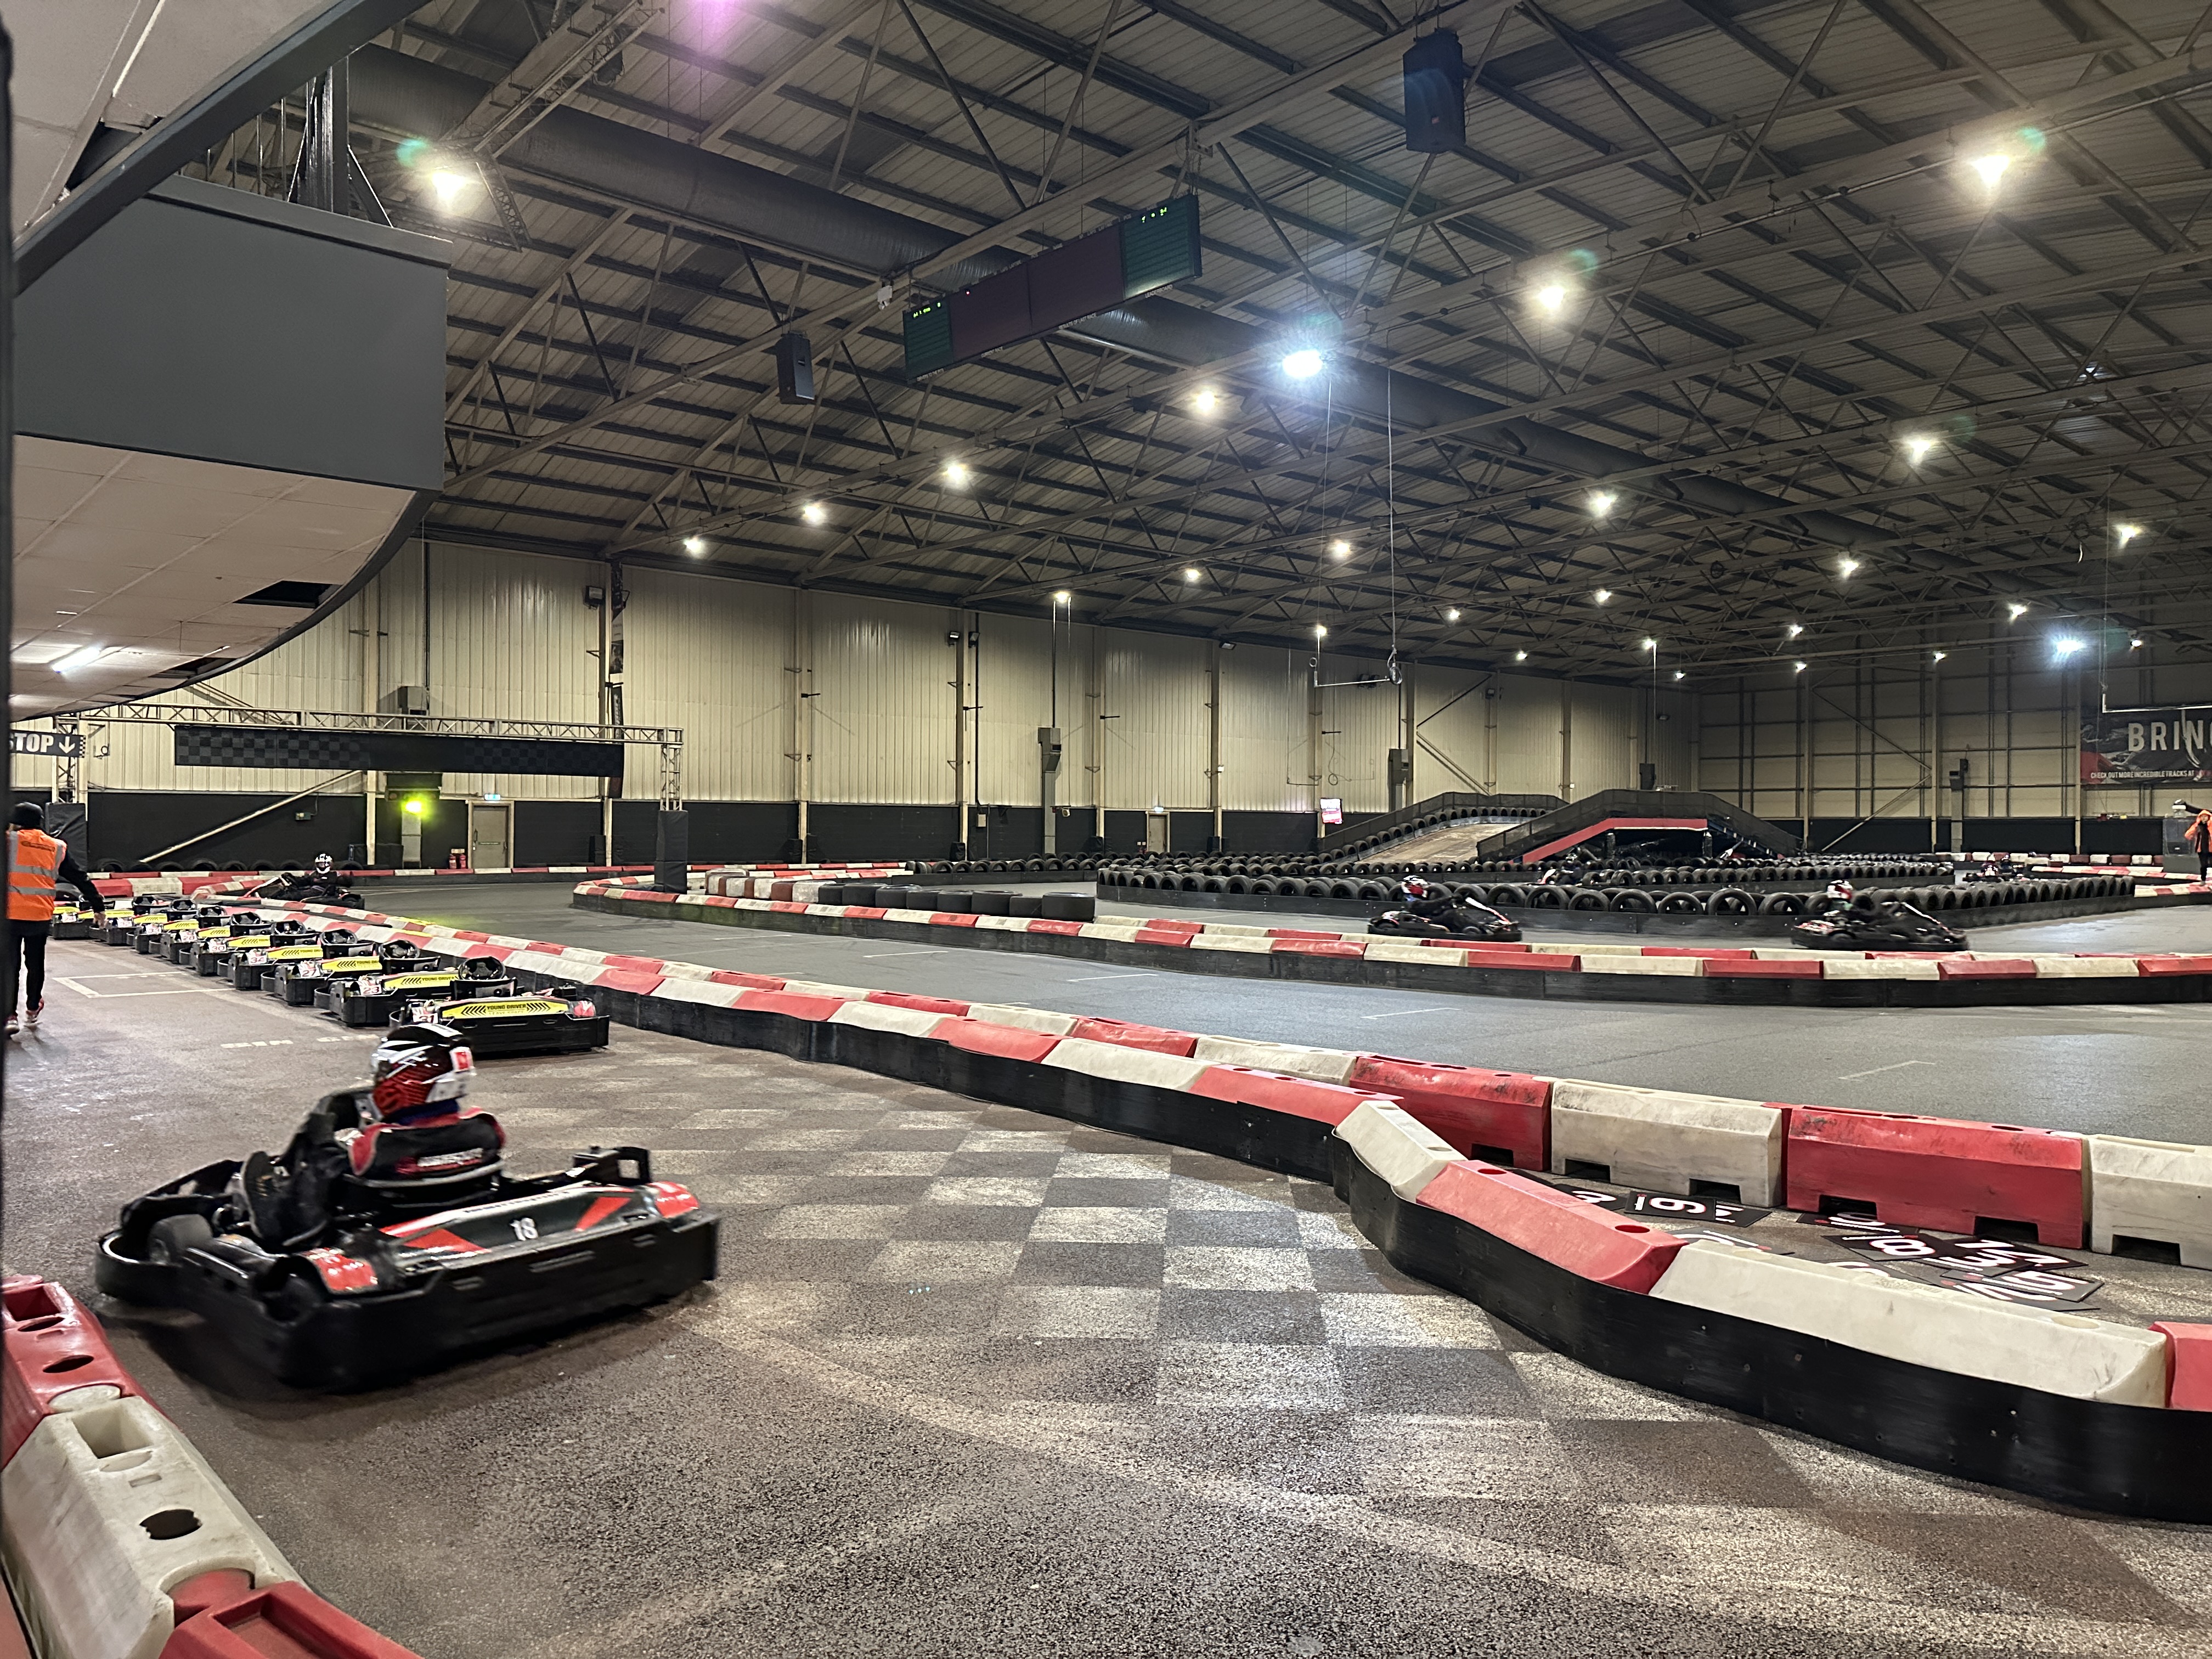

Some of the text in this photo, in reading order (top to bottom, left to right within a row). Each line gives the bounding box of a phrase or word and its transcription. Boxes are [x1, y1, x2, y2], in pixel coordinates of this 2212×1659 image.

[2128, 720, 2212, 752] BRIN
[363, 986, 380, 995] 23
[509, 1217, 538, 1241] 18
